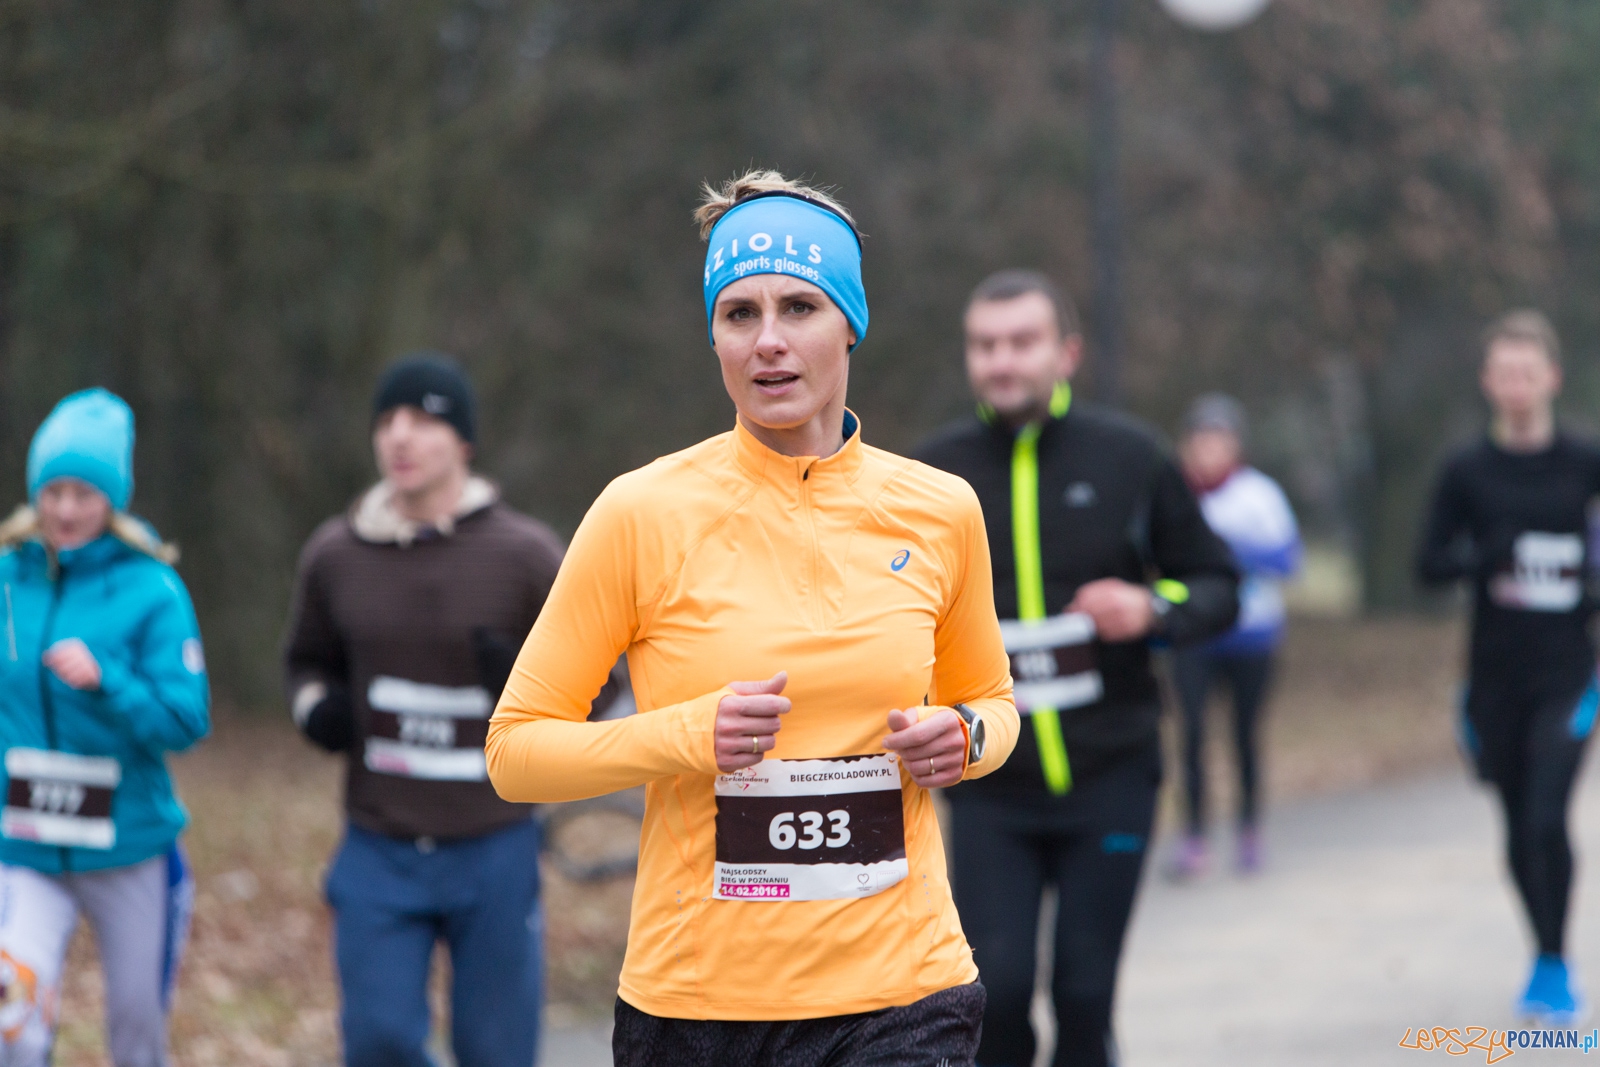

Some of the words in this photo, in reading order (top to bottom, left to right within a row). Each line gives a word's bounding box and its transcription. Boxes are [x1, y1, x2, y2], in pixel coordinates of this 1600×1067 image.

[704, 232, 823, 287] SZIOLS
[734, 255, 771, 277] sports
[774, 257, 819, 281] glasses
[790, 768, 892, 783] BIEGCZEKOLADOWY.PL
[768, 809, 851, 850] 633
[720, 868, 767, 876] NAJSŁODSZY
[721, 886, 778, 896] 14.02.2016
